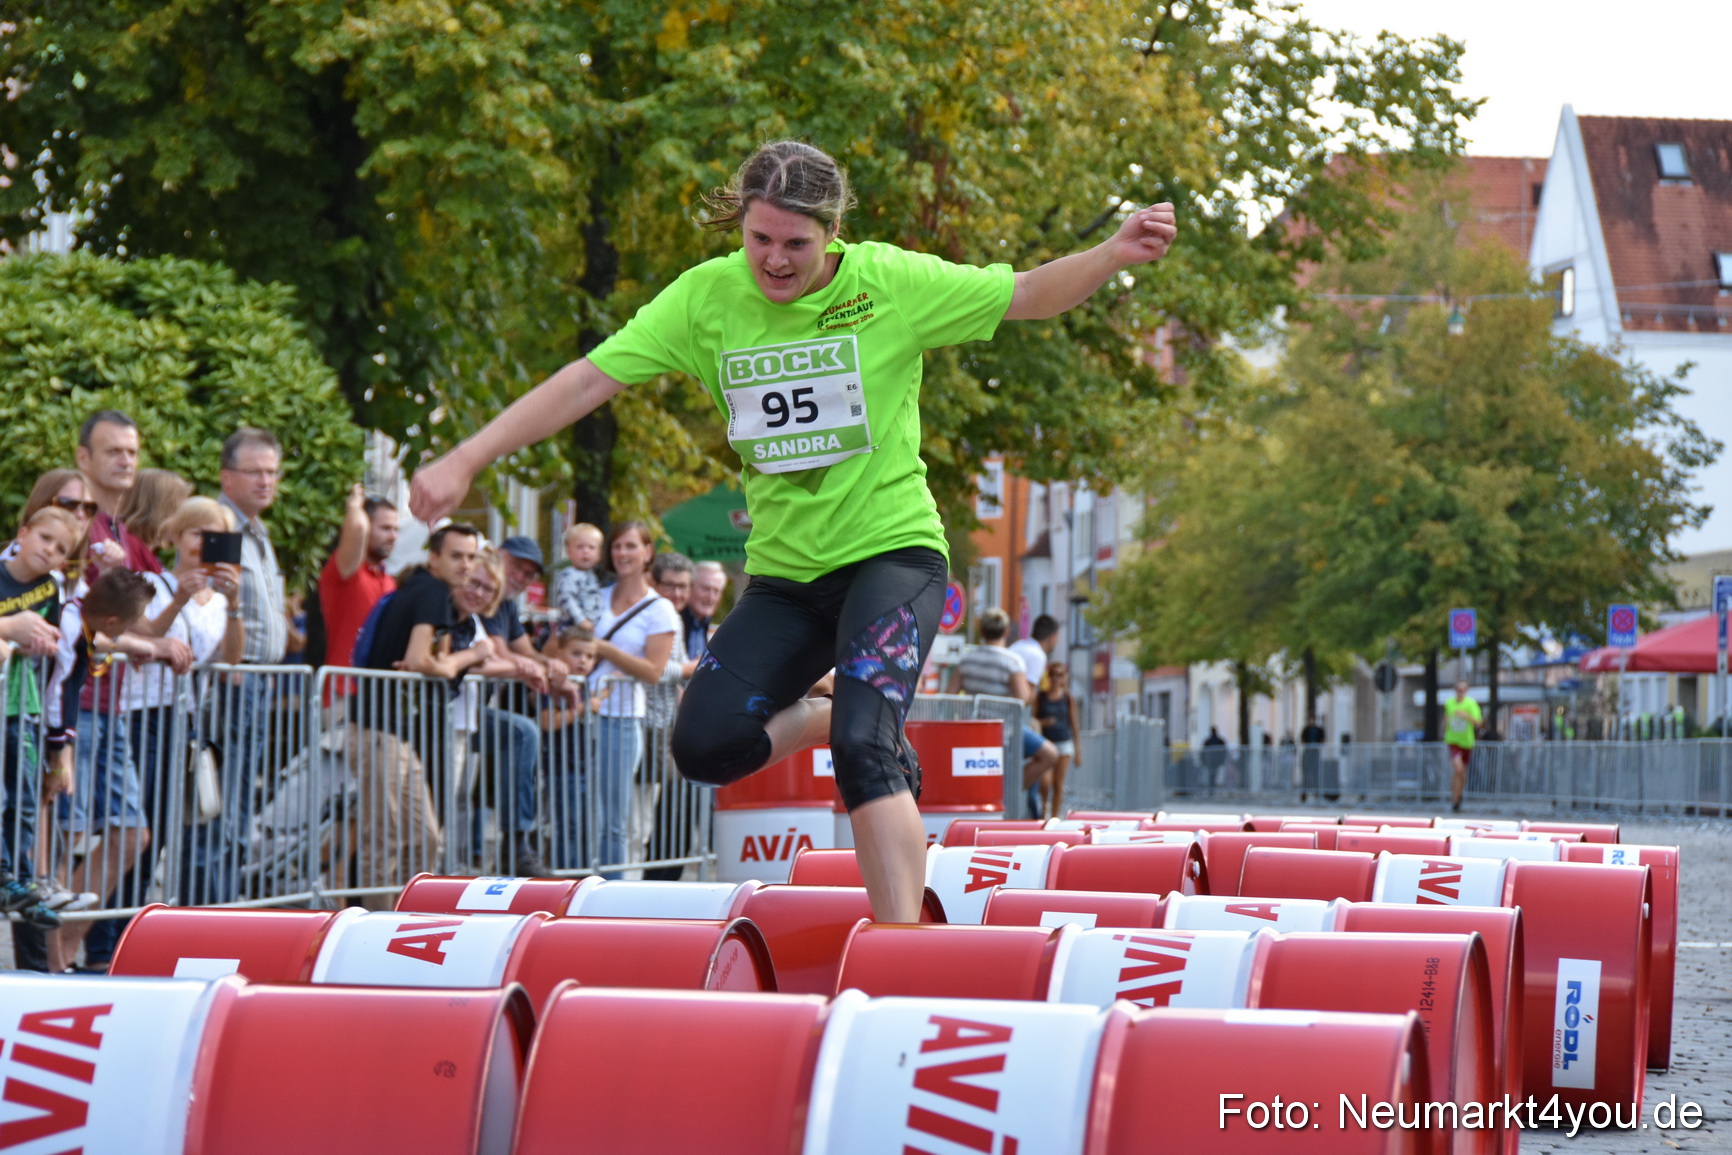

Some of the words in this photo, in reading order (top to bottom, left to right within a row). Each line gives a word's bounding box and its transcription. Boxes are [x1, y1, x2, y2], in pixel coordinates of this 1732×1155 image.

[825, 320, 859, 330] September
[728, 343, 844, 383] BOCK
[761, 387, 819, 428] 95
[753, 433, 842, 459] SANDRA
[1553, 1028, 1563, 1069] energie
[0, 1003, 113, 1155] VIA
[903, 1015, 1019, 1155] AVI
